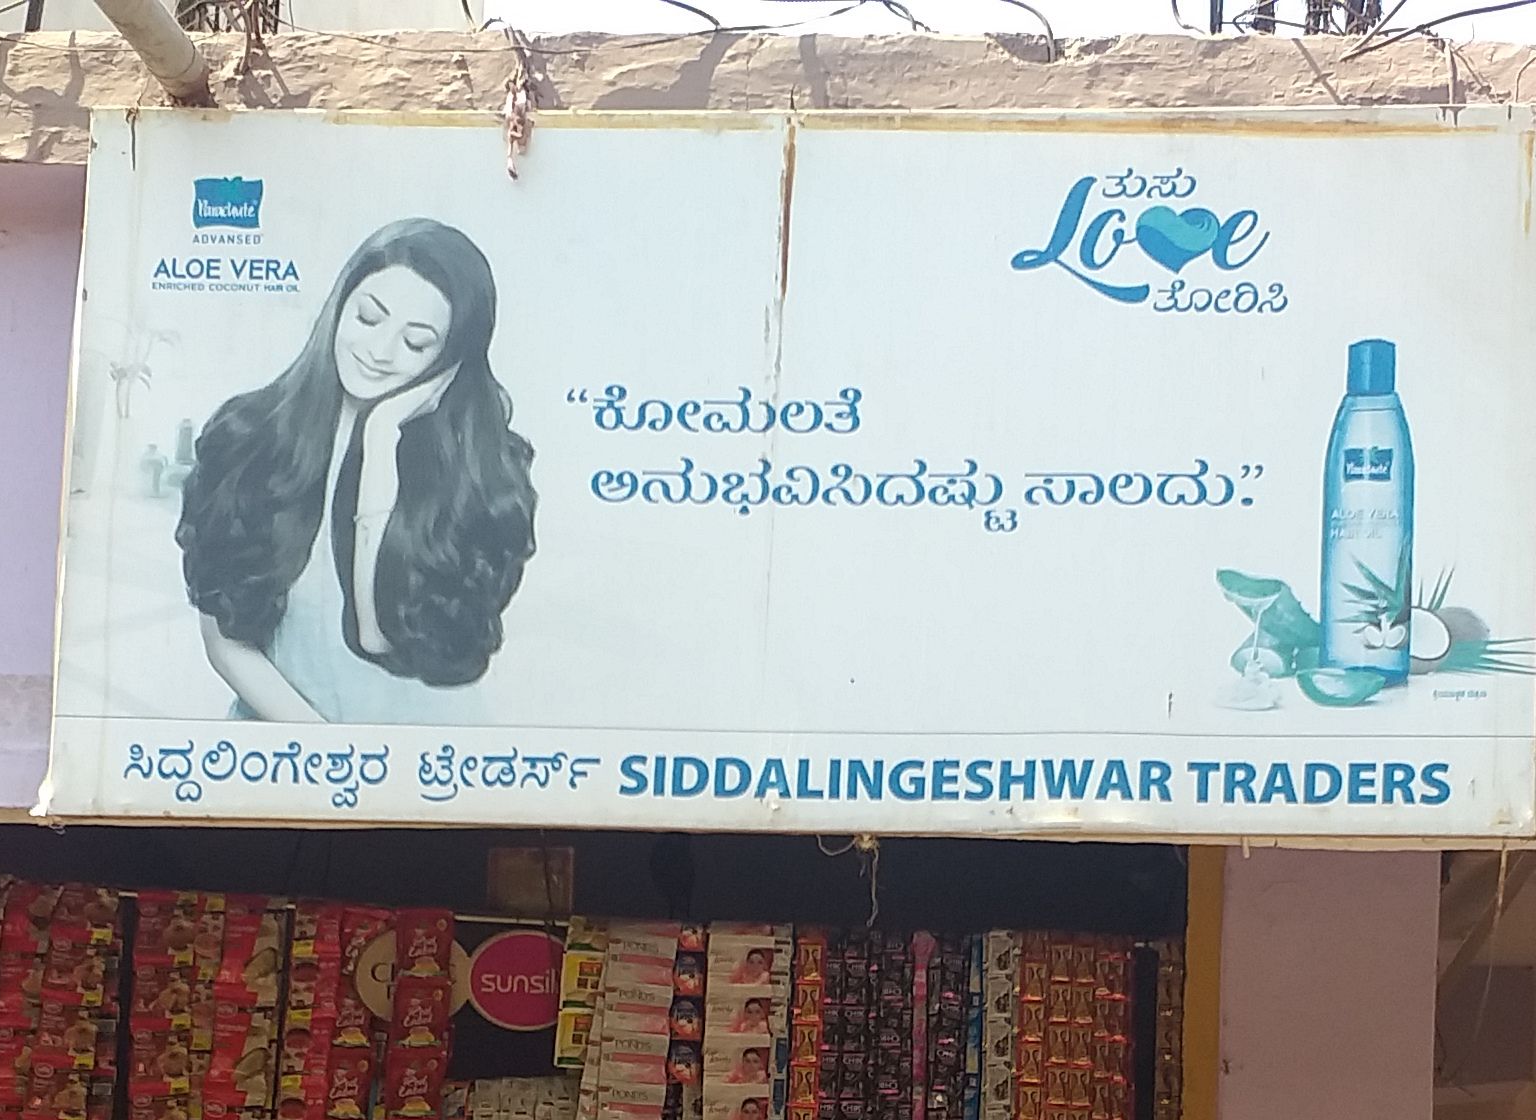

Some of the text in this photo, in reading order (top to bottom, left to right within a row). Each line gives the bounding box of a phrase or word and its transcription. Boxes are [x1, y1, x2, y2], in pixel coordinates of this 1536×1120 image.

[1102, 168, 1197, 199] ತುಸು
[153, 258, 300, 281] ALOE VERA
[152, 282, 301, 293] ENRICHED COCONUT HAIR OIL
[1153, 279, 1288, 314] ತೋರಿಸಿ
[590, 456, 1018, 534] ಅನುಭವಿಸಿದಷ್ಟು
[123, 739, 1451, 808] ಸಿದ್ದಲಿಂಗೇಶ್ವರ ಟ್ರೇಡರ್ಸ್ SIDDALINGESHWAR TRADERS
